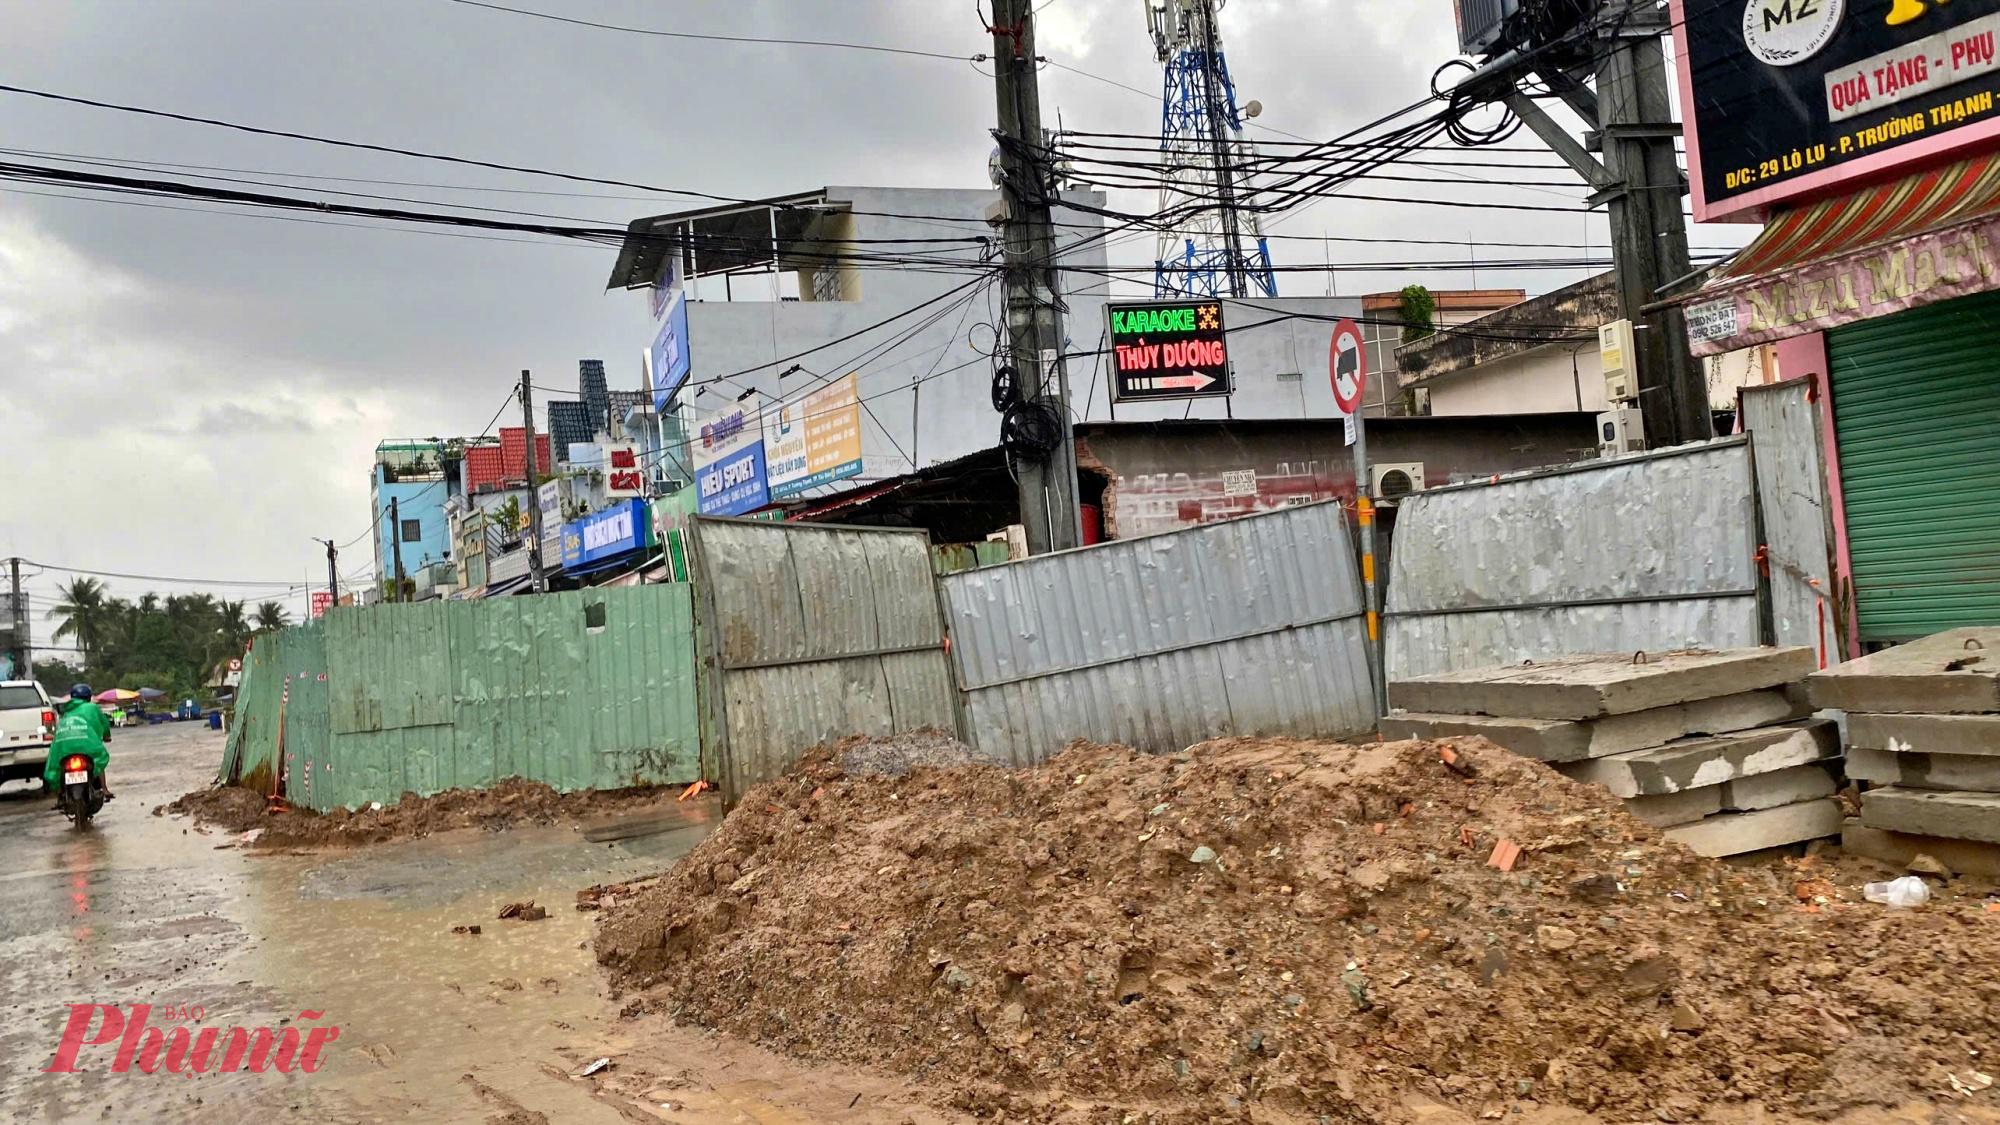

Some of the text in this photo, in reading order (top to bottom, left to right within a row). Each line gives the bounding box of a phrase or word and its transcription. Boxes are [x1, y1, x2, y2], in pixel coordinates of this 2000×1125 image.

[1763, 0, 1818, 32] MZ
[1831, 71, 1870, 111] QUÀ
[1874, 55, 1928, 97] TẶNG
[1951, 30, 1995, 70] PHỤ
[1725, 168, 1757, 189] Đ/C:
[1759, 159, 1779, 179] 29
[1783, 149, 1802, 171] LÒ
[1806, 144, 1825, 164] LU
[1839, 136, 1854, 154] P.
[1856, 116, 1925, 149] TRƯỜNG
[1929, 91, 1993, 126] THẠNH
[1746, 229, 1994, 333] Mizu Mart
[1113, 308, 1196, 333] KARAOKE
[1163, 339, 1225, 368] DƯƠNG
[611, 447, 635, 468] NHÀ
[609, 469, 640, 490] SÁCH
[700, 454, 755, 498] HIẾU SPORT
